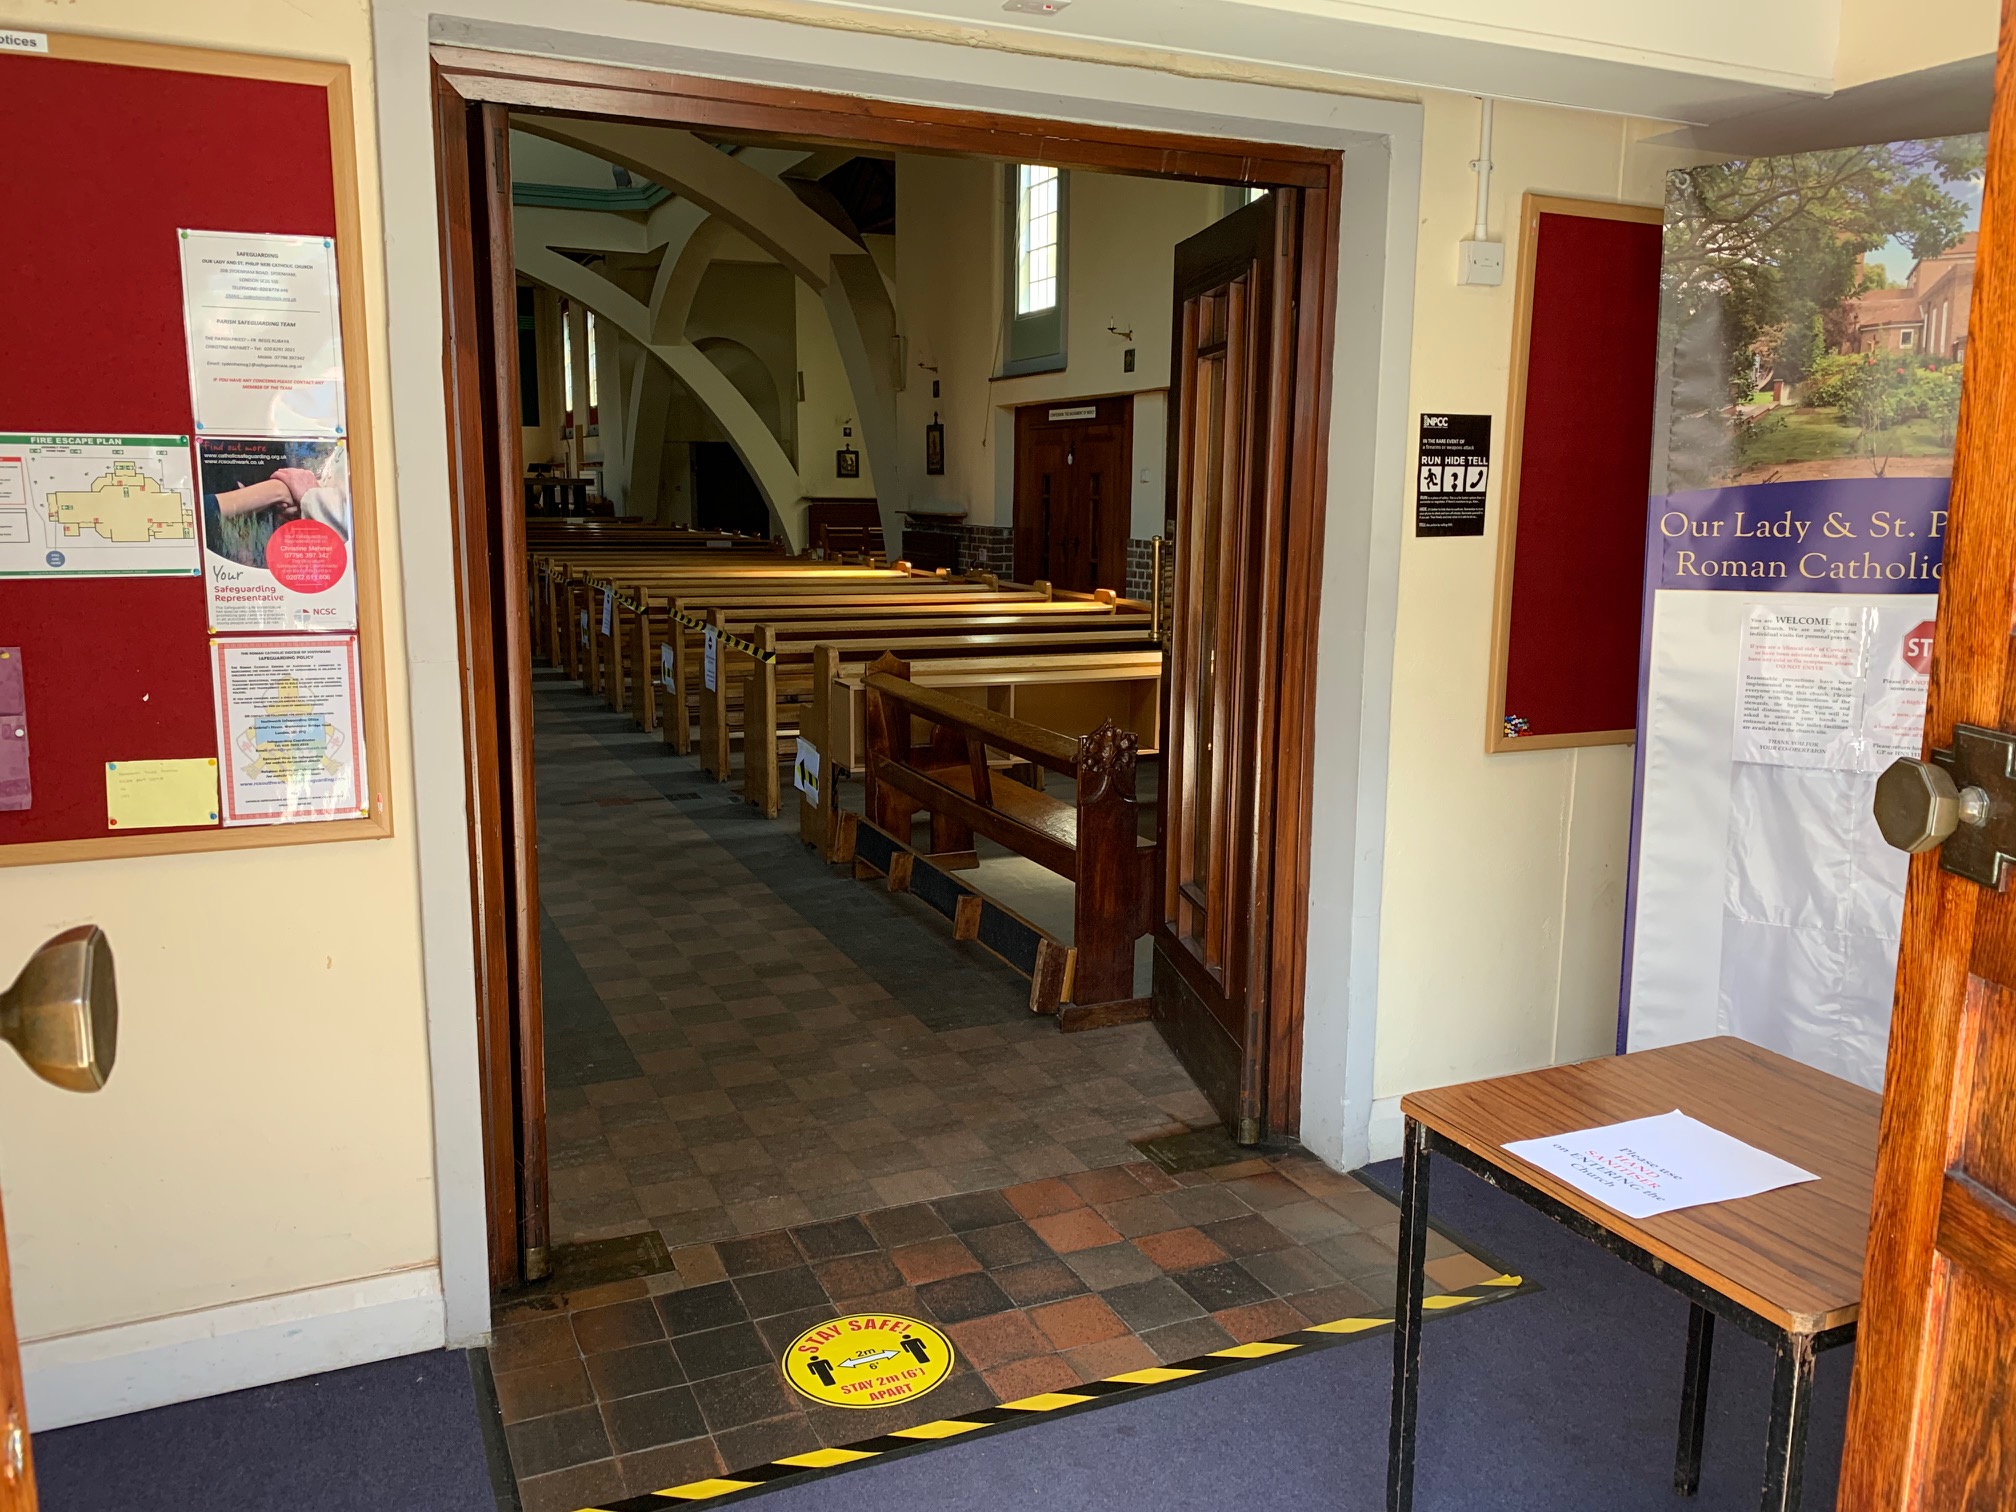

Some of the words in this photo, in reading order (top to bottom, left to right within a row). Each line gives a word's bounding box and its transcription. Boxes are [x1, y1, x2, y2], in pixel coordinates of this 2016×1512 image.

[1427, 417, 1448, 426] NPCC
[55, 437, 94, 445] ESCAPE
[203, 441, 223, 451] Find
[228, 442, 241, 451] out
[245, 444, 266, 452] more
[1421, 456, 1441, 465] RUN
[1445, 456, 1465, 465] HIDE
[1467, 457, 1488, 465] TELL
[1660, 512, 1725, 538] Our
[1734, 510, 1811, 544] Lady
[1823, 512, 1857, 538] &
[1869, 511, 1915, 538] St.
[213, 565, 244, 583] Your
[1675, 550, 1788, 578] Roman
[1799, 552, 1942, 580] Catholic
[214, 585, 276, 594] Safeguarding
[215, 594, 285, 603] Representative
[313, 608, 337, 616] NCSC
[1776, 616, 1832, 626] WELCOME
[1552, 1143, 1569, 1153] on
[1570, 1152, 1644, 1191] ENTERING
[1643, 1190, 1666, 1201] the
[1585, 1149, 1661, 1189] SANITISER
[1614, 1155, 1660, 1179] HAND
[1619, 1147, 1659, 1169] Please
[1659, 1168, 1683, 1180] use
[1571, 1163, 1616, 1188] Church
[798, 1324, 842, 1354] STAY
[848, 1318, 912, 1334] SAFE!
[855, 1349, 876, 1358] 2m
[869, 1362, 879, 1370] 6'
[840, 1379, 874, 1395] STAY
[876, 1373, 900, 1387] 2m
[869, 1383, 914, 1401] APART
